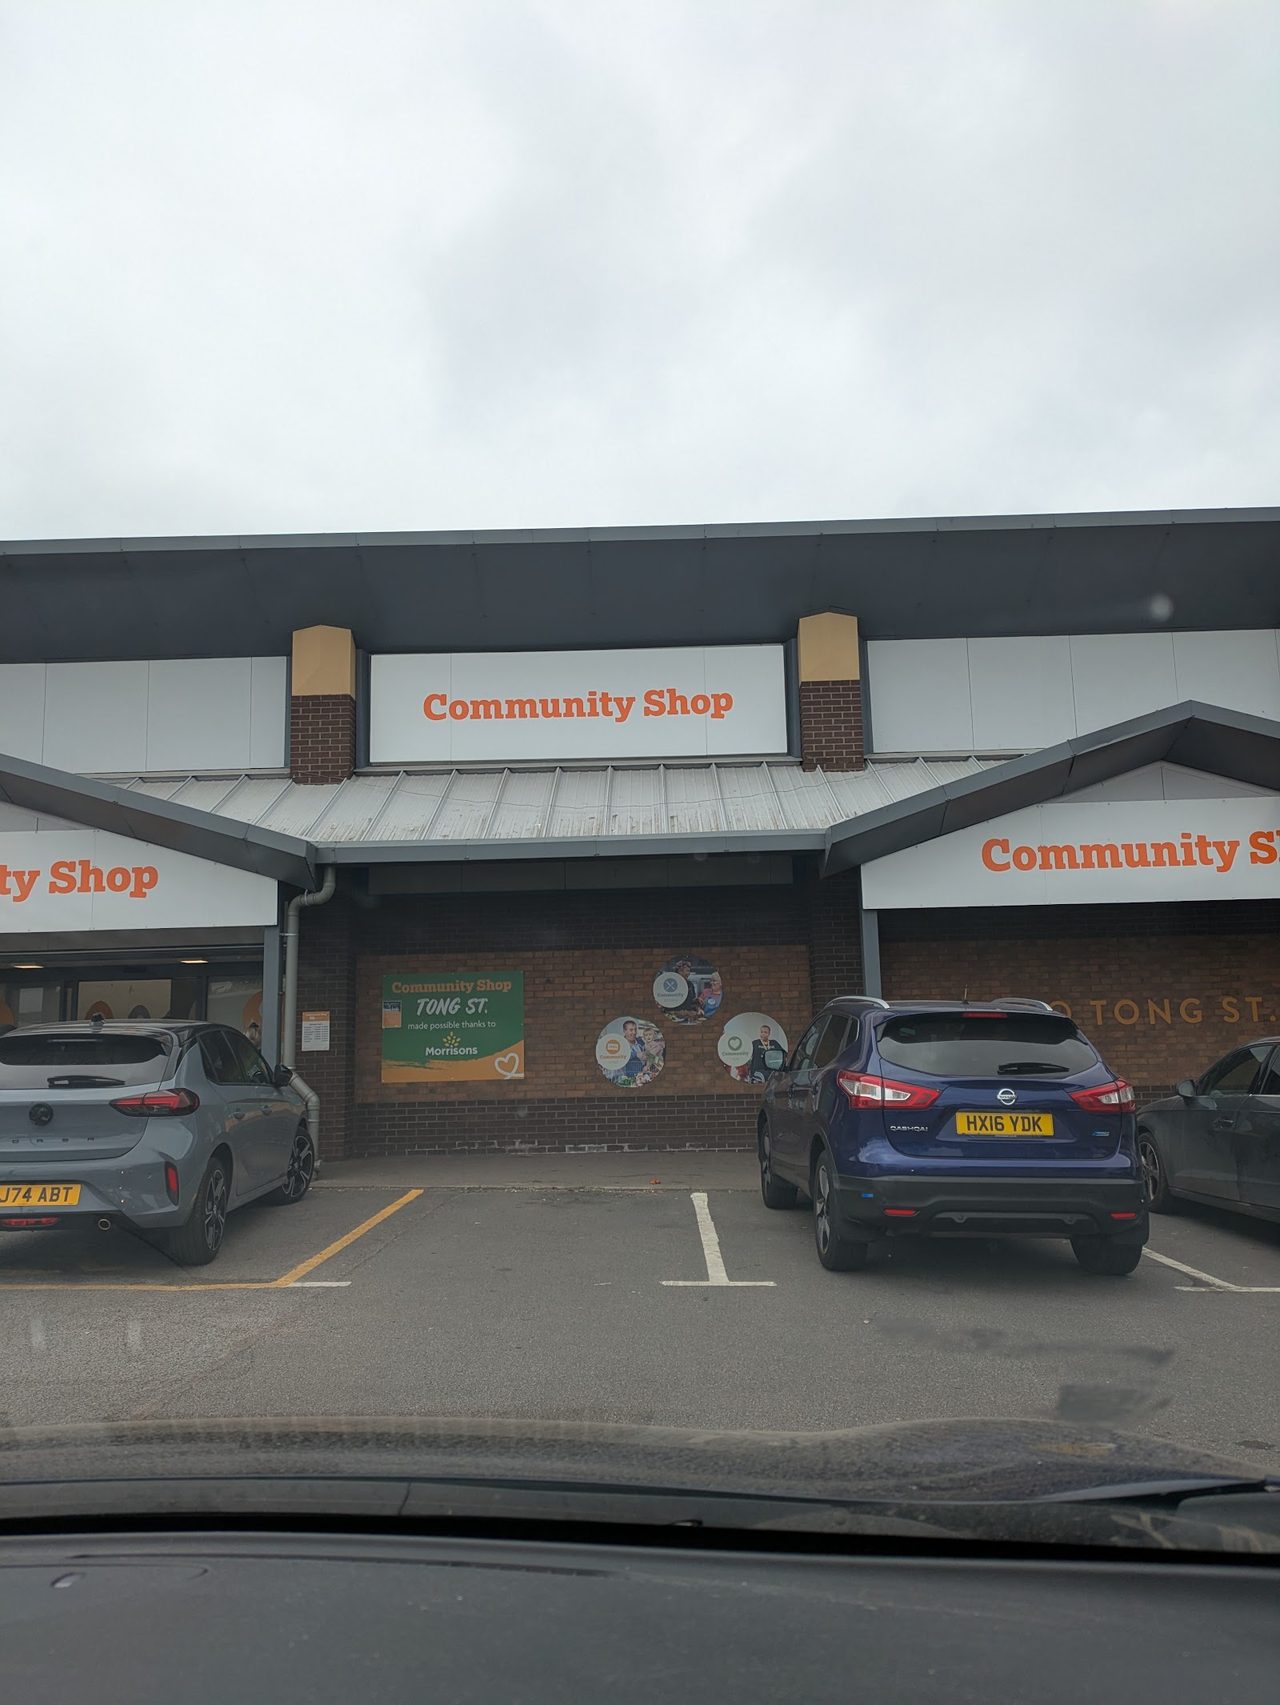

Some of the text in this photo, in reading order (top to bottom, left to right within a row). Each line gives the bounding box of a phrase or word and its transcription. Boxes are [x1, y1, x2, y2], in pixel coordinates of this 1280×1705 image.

[423, 688, 734, 723] Community Shop
[981, 830, 1280, 873] Community S
[49, 860, 159, 899] Shop
[392, 979, 512, 994] Community Shop
[416, 997, 461, 1016] TONG
[465, 997, 489, 1015] ST.
[1089, 997, 1203, 1026] TONG
[1220, 995, 1277, 1024] ST.
[407, 1020, 496, 1031] made possible thanks to
[425, 1046, 478, 1056] Morrisons
[966, 1114, 1043, 1133] HX16 YDK
[37, 1186, 73, 1203] ABT
